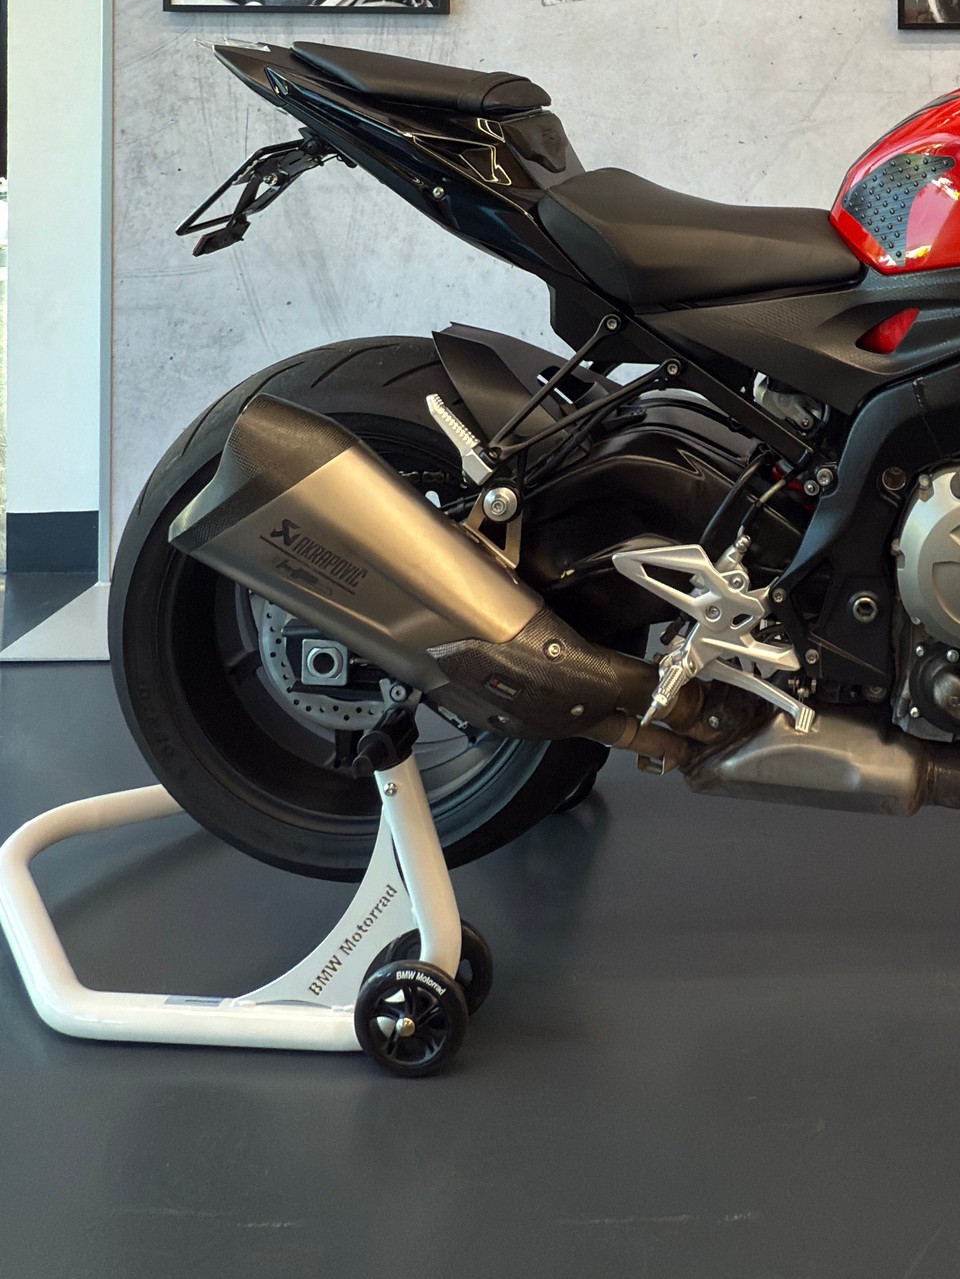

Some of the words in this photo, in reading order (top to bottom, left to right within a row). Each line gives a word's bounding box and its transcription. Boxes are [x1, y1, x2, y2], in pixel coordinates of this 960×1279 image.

[308, 955, 343, 996] BMW
[339, 884, 398, 956] Motorrad
[396, 970, 417, 981] BMW
[415, 971, 447, 996] Motorrad
